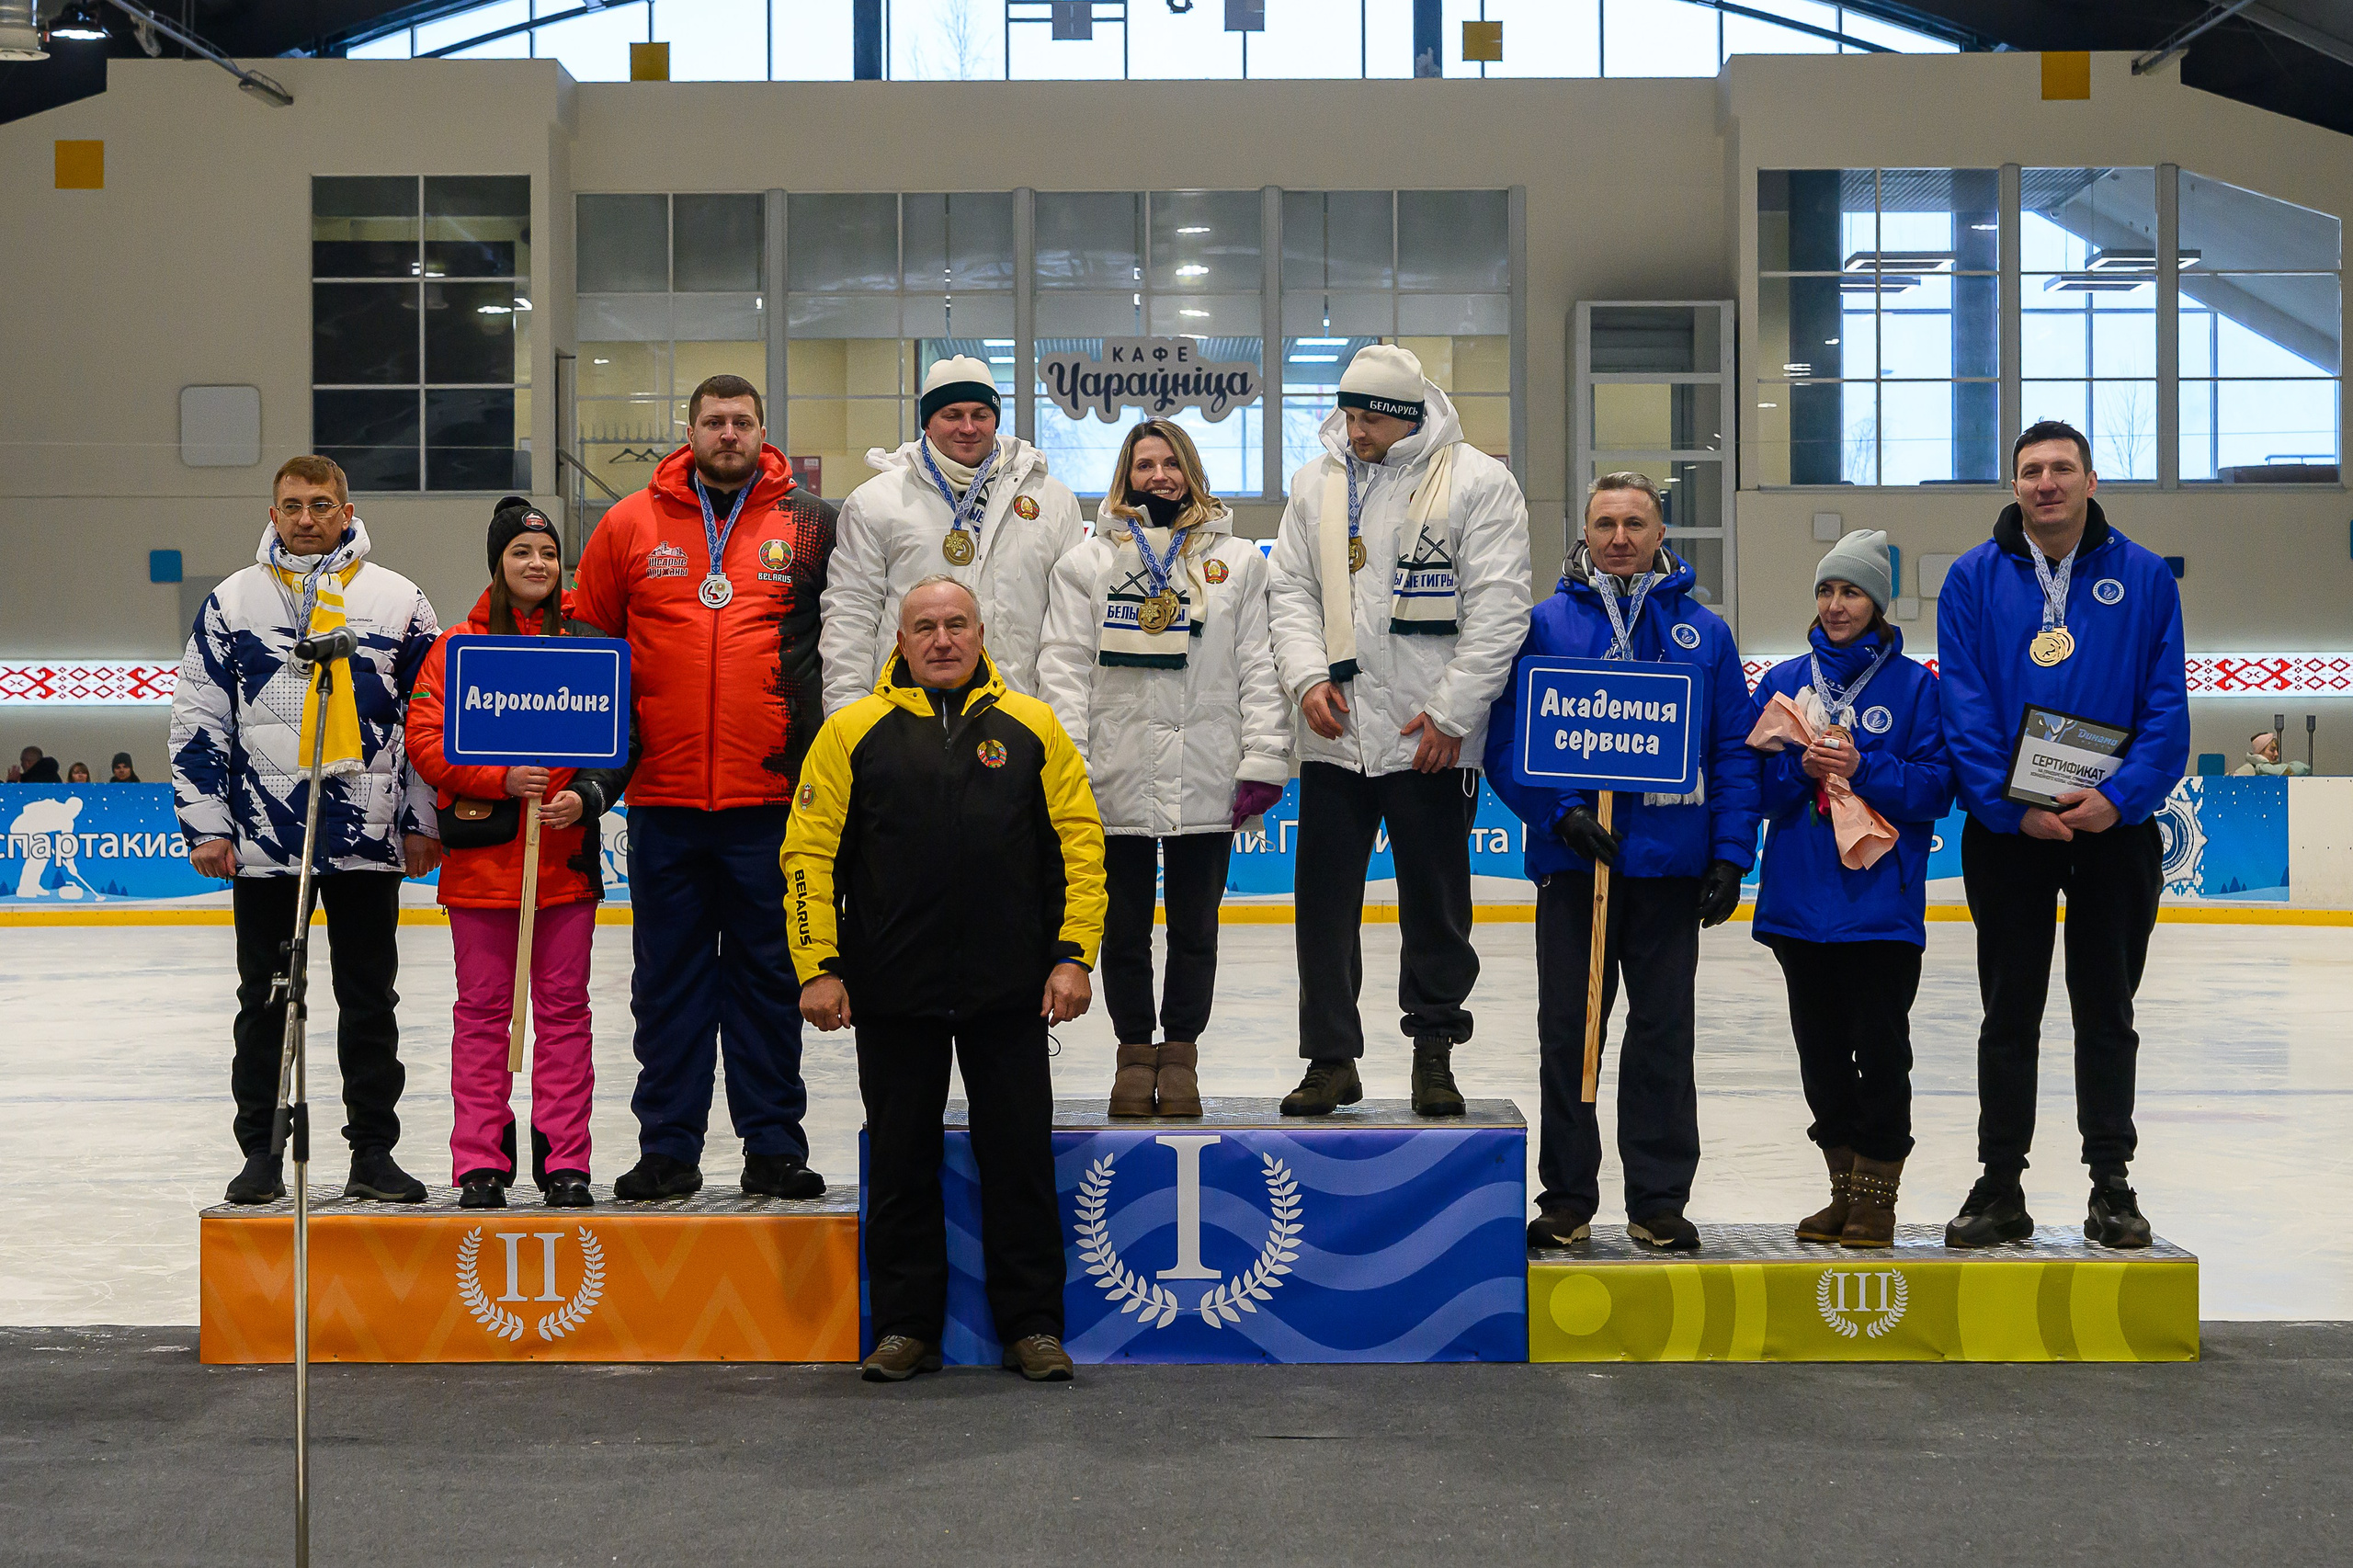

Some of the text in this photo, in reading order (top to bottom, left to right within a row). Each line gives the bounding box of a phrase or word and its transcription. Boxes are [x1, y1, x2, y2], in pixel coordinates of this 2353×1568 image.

[1113, 347, 1188, 362] КАФЕ
[1048, 362, 1253, 414] Чараўніца
[1370, 400, 1418, 415] БЕЛАРУСЬ
[1108, 605, 1140, 620] БЕЛЫ
[465, 686, 609, 717] Агрохолдинг
[1540, 687, 1677, 723] Академия
[1554, 728, 1660, 760] сервиса
[2032, 754, 2106, 780] СЕРТИФИКАТ
[0, 832, 192, 868] партакиа
[794, 869, 813, 947] BELARUS
[1155, 1135, 1222, 1279] I
[495, 1233, 565, 1301] II
[1832, 1272, 1893, 1312] III
